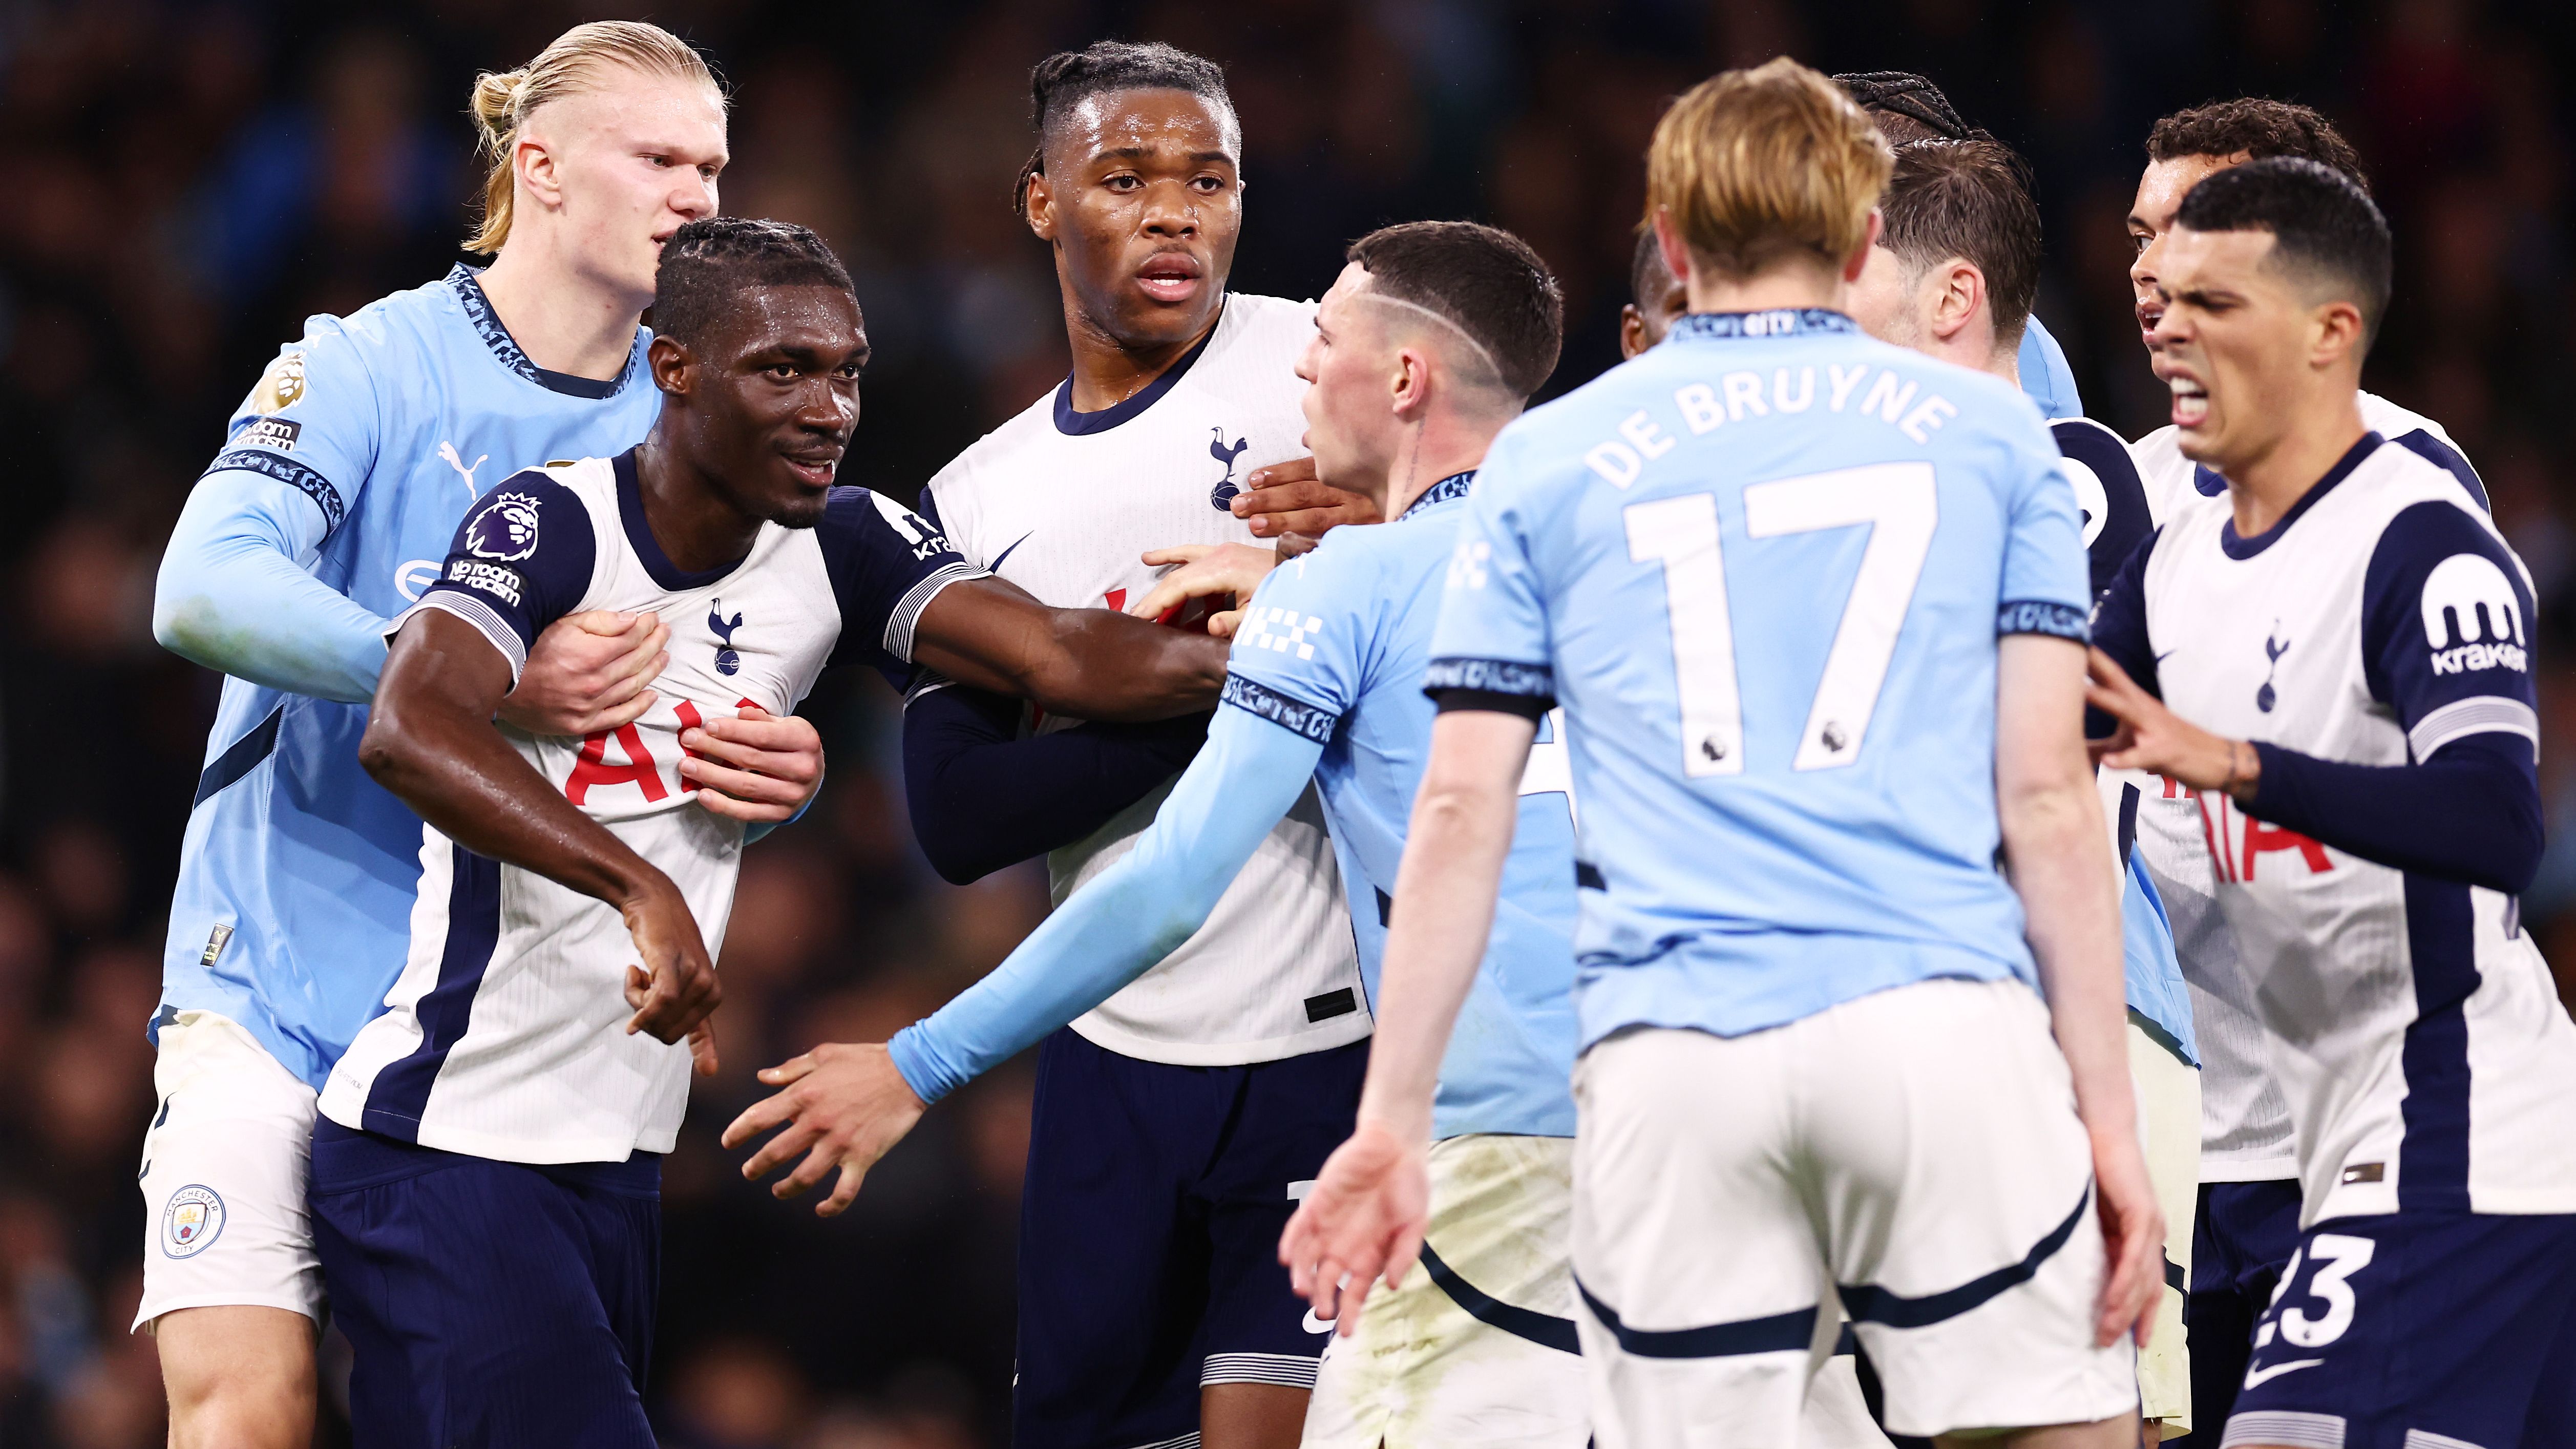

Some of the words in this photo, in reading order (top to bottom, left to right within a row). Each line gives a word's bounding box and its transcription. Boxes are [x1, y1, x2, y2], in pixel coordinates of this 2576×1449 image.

[1585, 409, 1677, 490] DE
[1674, 363, 1959, 445] BRUYNE
[912, 536, 951, 561] kra
[450, 560, 471, 575] No
[471, 563, 520, 590] room
[464, 576, 521, 607] racism
[1622, 459, 1940, 778] 17
[167, 1190, 219, 1216] MANCHESTER
[175, 1245, 194, 1254] CITY
